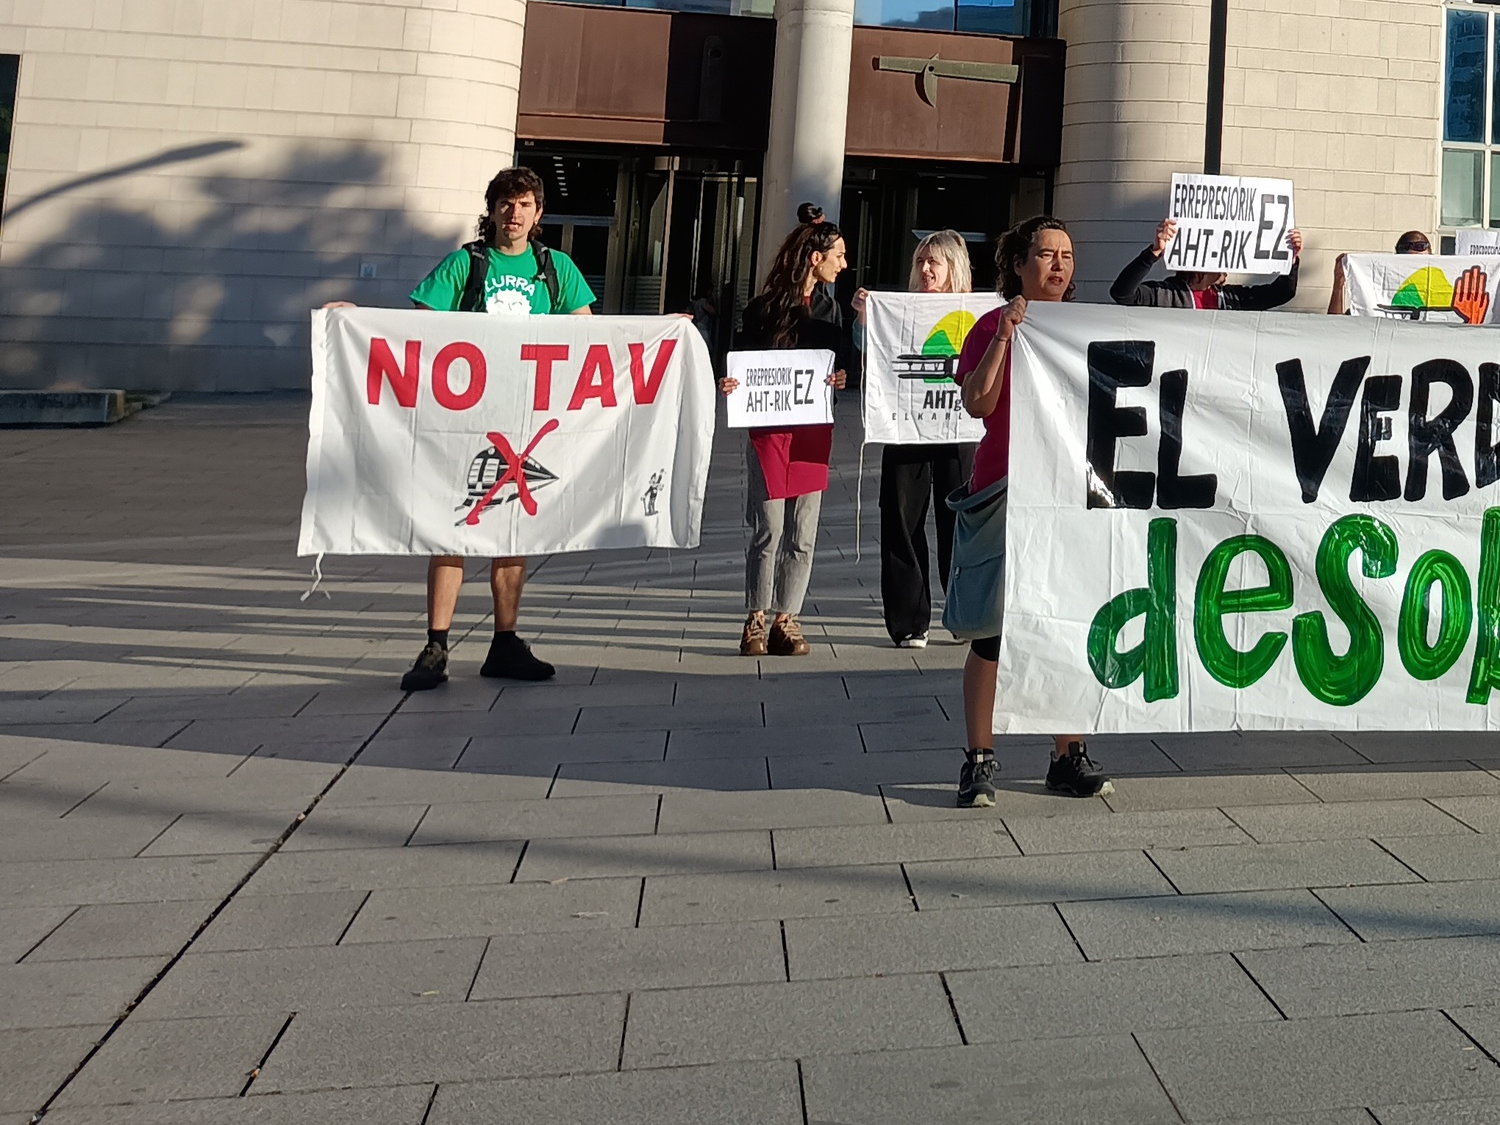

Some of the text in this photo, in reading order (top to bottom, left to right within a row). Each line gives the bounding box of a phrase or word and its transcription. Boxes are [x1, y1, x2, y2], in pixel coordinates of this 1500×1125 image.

[1173, 184, 1289, 260] ERREPRESIORIK EZ
[1168, 227, 1253, 269] AHT-RIK
[484, 274, 536, 297] LURRA
[367, 338, 678, 411] NO TAV
[746, 367, 815, 405] ERREPRESIORIK EZ
[746, 390, 792, 412] AHT-RIK
[1087, 341, 1217, 509] EL
